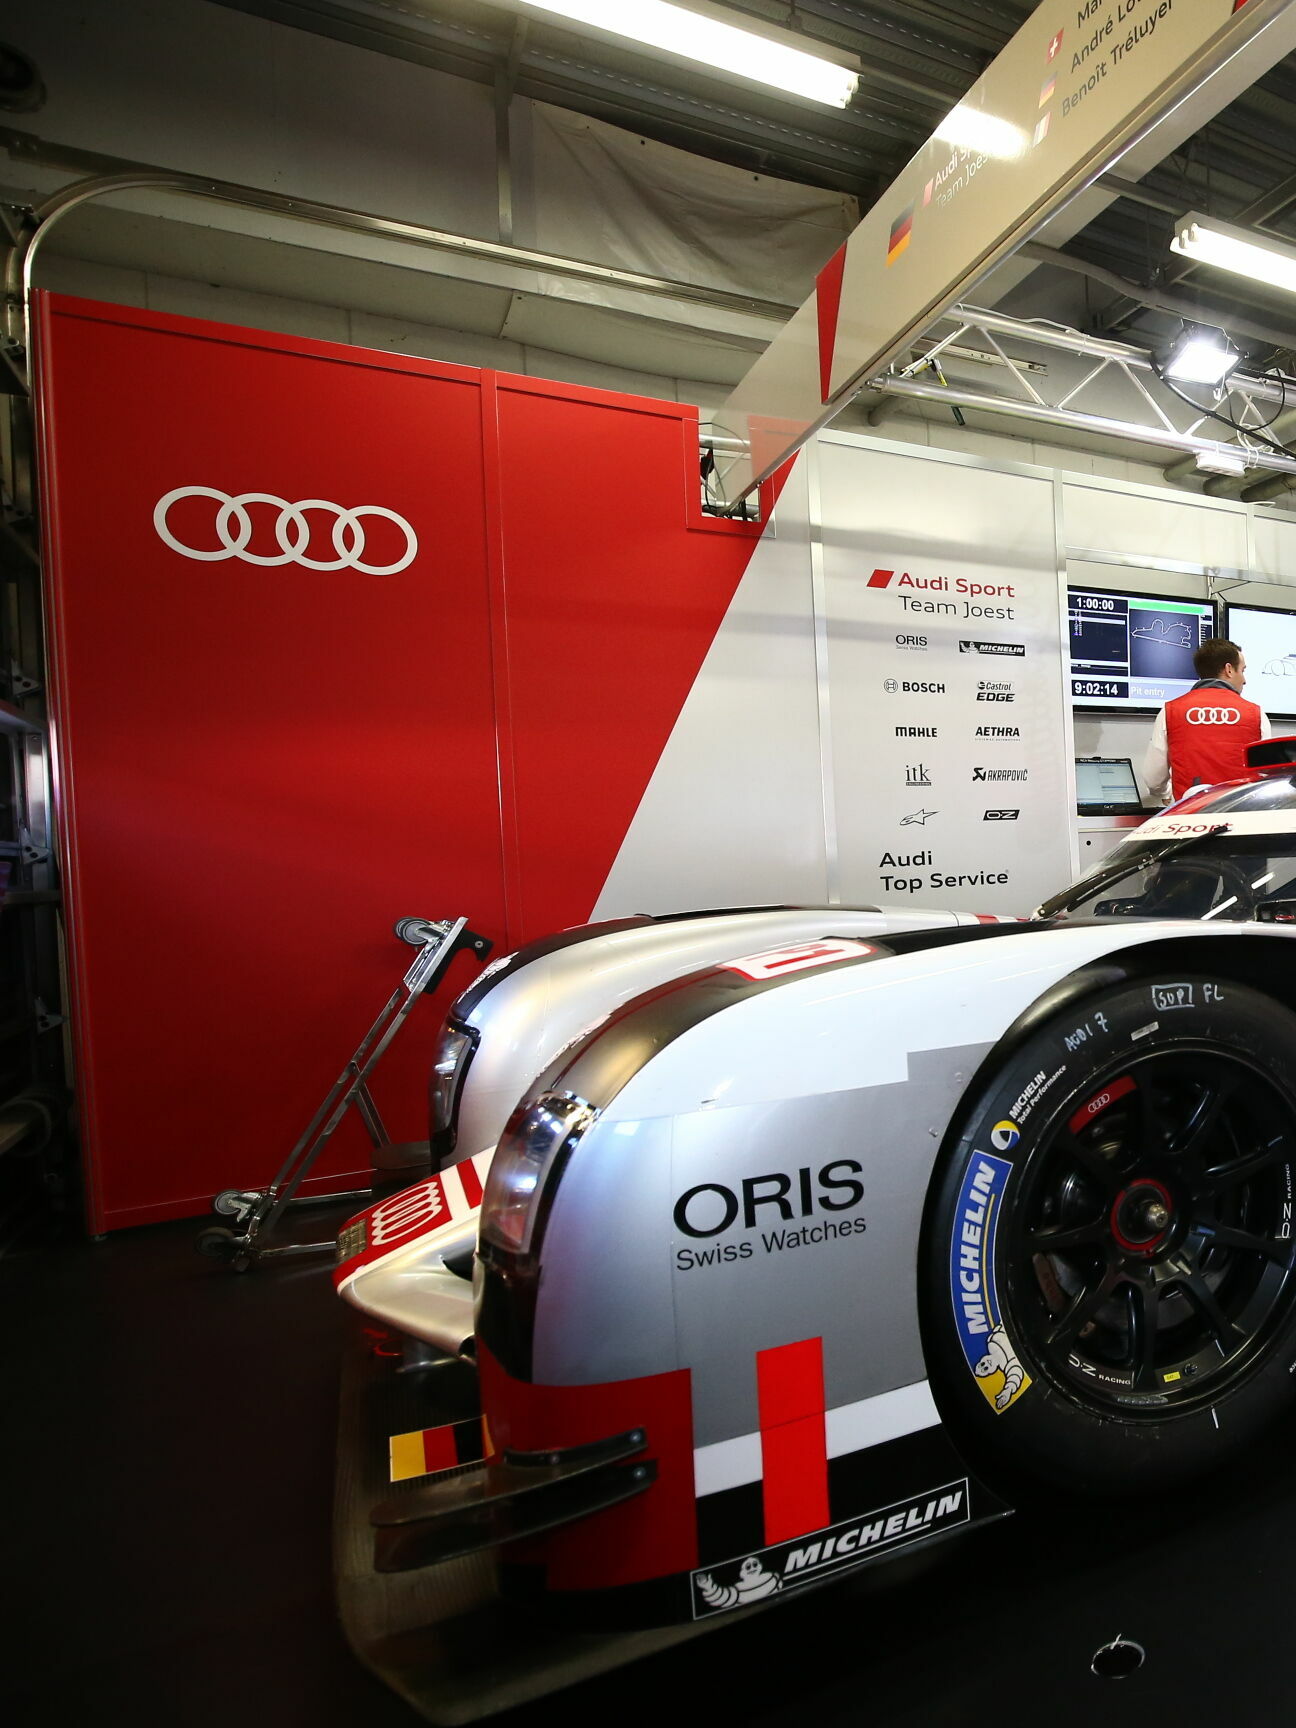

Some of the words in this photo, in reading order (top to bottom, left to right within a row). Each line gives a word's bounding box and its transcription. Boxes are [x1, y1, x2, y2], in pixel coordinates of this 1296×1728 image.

[1070, 14, 1113, 74] André
[934, 150, 959, 191] Audi
[898, 572, 949, 592] Audi
[955, 577, 1015, 598] Sport
[898, 595, 957, 615] Team
[963, 601, 1015, 620] Joest
[1076, 597, 1115, 611] 1:00:00
[895, 634, 928, 647] ORIS
[979, 644, 1024, 653] MICHELIN
[902, 681, 945, 694] BOSCH
[986, 681, 1012, 691] Castrol
[1074, 682, 1119, 696] 9:02:14
[1130, 686, 1143, 696] Pit
[1143, 688, 1166, 701] entry
[976, 692, 1015, 703] EDGE
[895, 726, 938, 738] MAHLE
[975, 726, 1020, 737] AETHRA
[905, 763, 931, 782] itk
[879, 851, 933, 868] Audi
[880, 874, 923, 894] Top
[930, 870, 1009, 888] Service
[1203, 983, 1225, 1004] FL
[1094, 1012, 1109, 1033] 7
[1008, 1070, 1047, 1119] MICHELIN
[1016, 1103, 1033, 1126] Total
[1028, 1064, 1067, 1107] Performance
[673, 1159, 865, 1239] ORIS
[676, 1243, 753, 1271] Swiss
[761, 1217, 867, 1254] Watches
[967, 1160, 996, 1335] MICHELIN
[1098, 1373, 1132, 1386] RACING
[784, 1490, 963, 1574] MICHELIN
